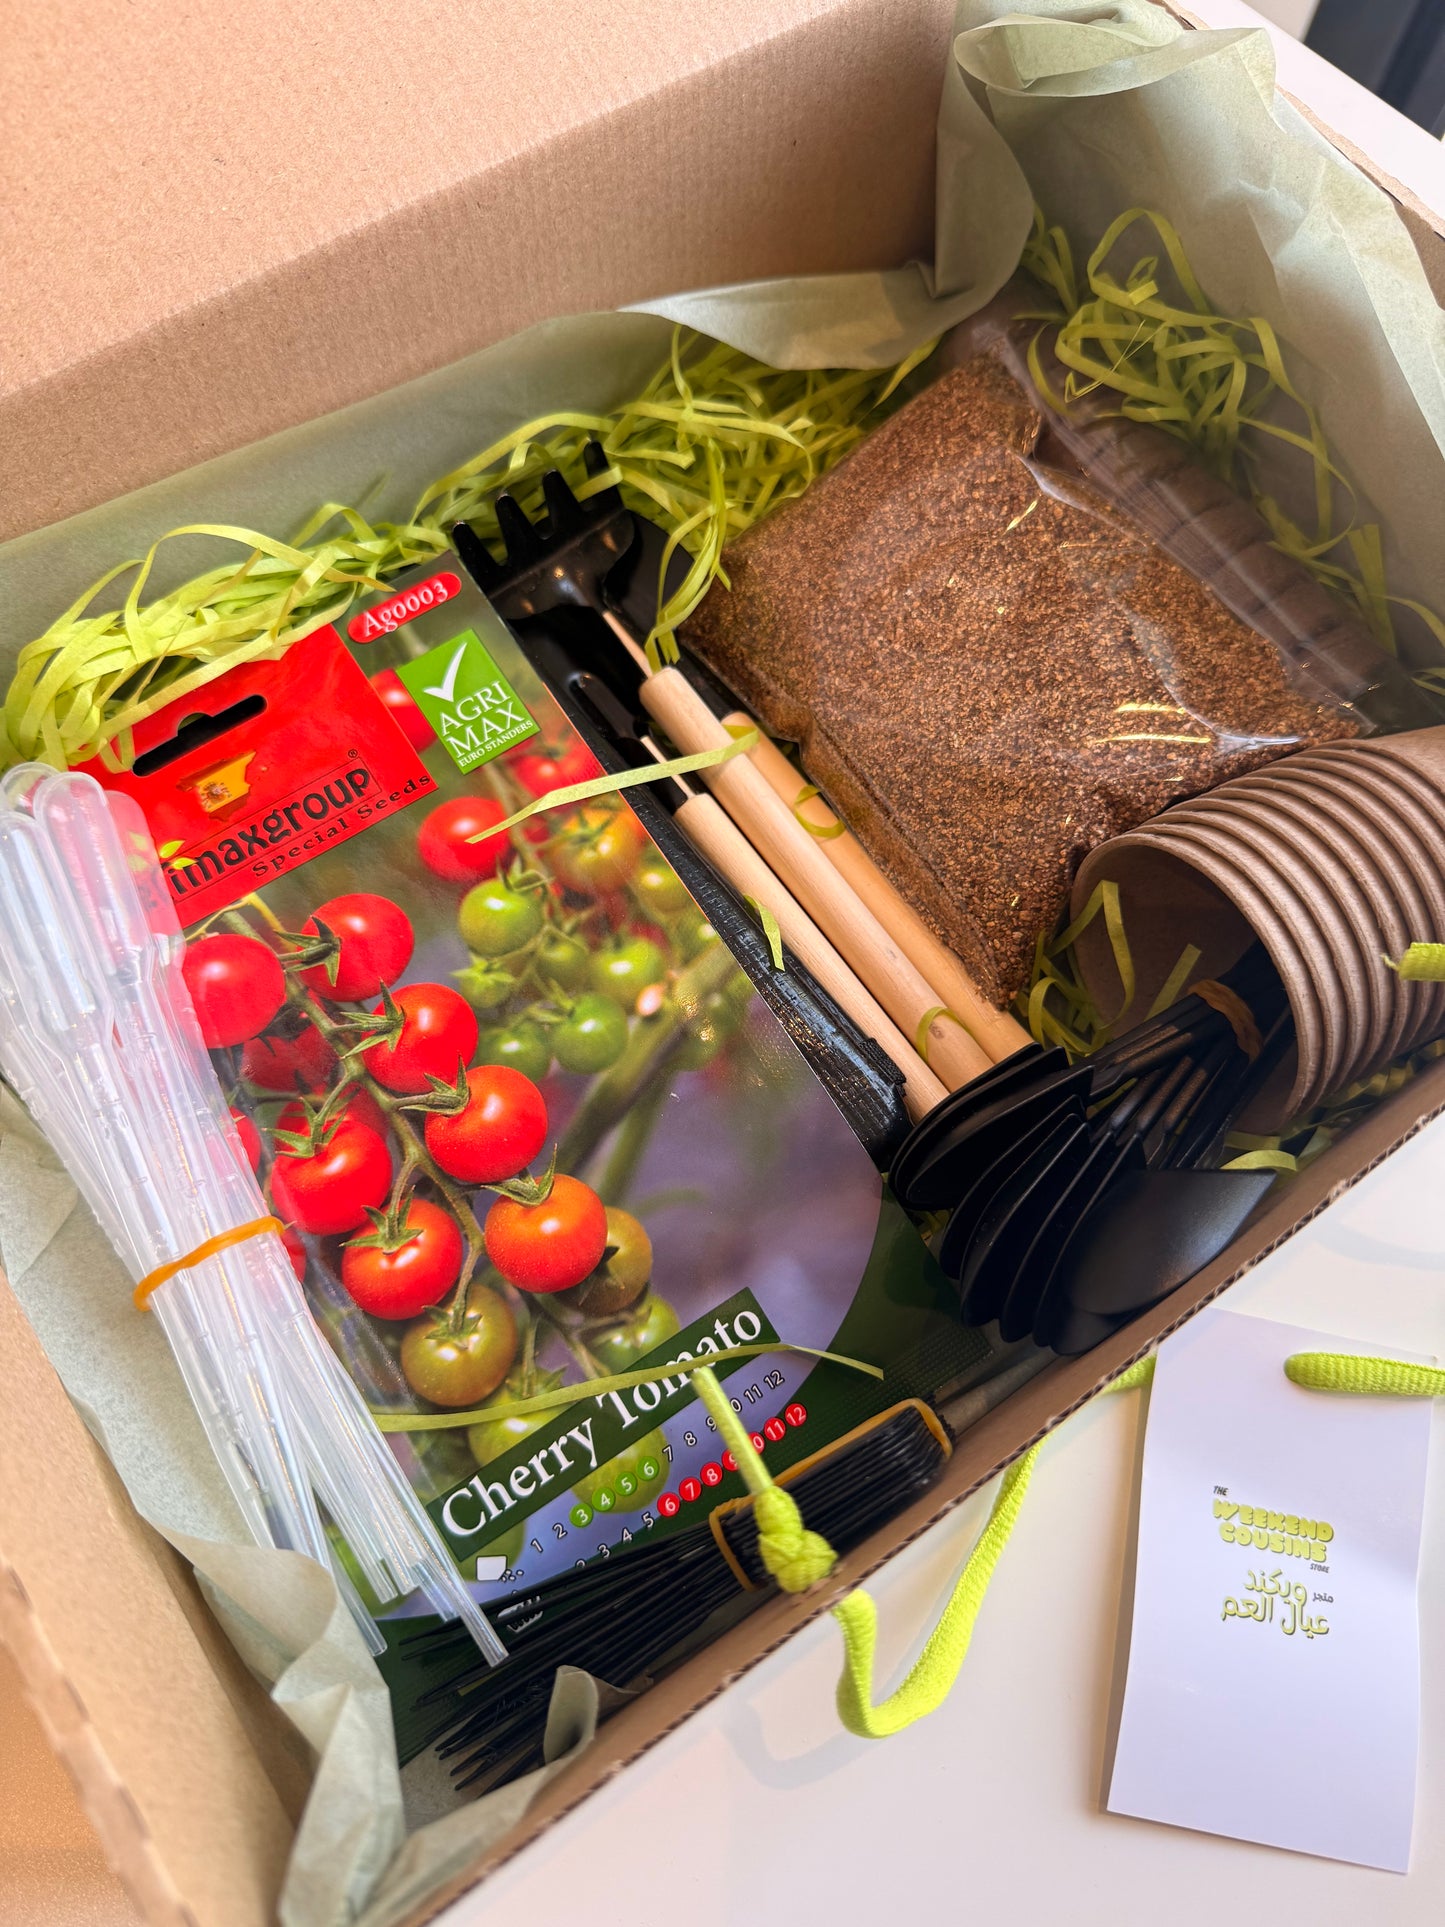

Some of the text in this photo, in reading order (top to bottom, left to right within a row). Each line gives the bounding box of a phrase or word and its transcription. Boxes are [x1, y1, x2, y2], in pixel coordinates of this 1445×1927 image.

[439, 681, 511, 737] AGRI
[446, 702, 524, 759] MAX
[457, 720, 533, 768] EURO STANDERS
[252, 775, 431, 877] Special Seeds
[441, 1310, 762, 1538] Cherry Tomato
[531, 1369, 785, 1553] 1 2 3 4 5 6 7 8 9 0 11 12
[598, 1543, 611, 1559] 3
[621, 1527, 632, 1543] 4
[642, 1512, 654, 1528] 5
[664, 1499, 677, 1513] 6
[685, 1482, 696, 1498] 7
[706, 1468, 719, 1482] 8
[766, 1421, 786, 1439] 11
[786, 1406, 807, 1426] 12
[1213, 1485, 1229, 1496] THE
[1212, 1498, 1335, 1543] WEEKEND
[1218, 1521, 1328, 1563] COUSINS
[1243, 1568, 1334, 1606] متجر ويكند
[1309, 1562, 1331, 1574] STORE
[1220, 1595, 1330, 1640] عيال العم
